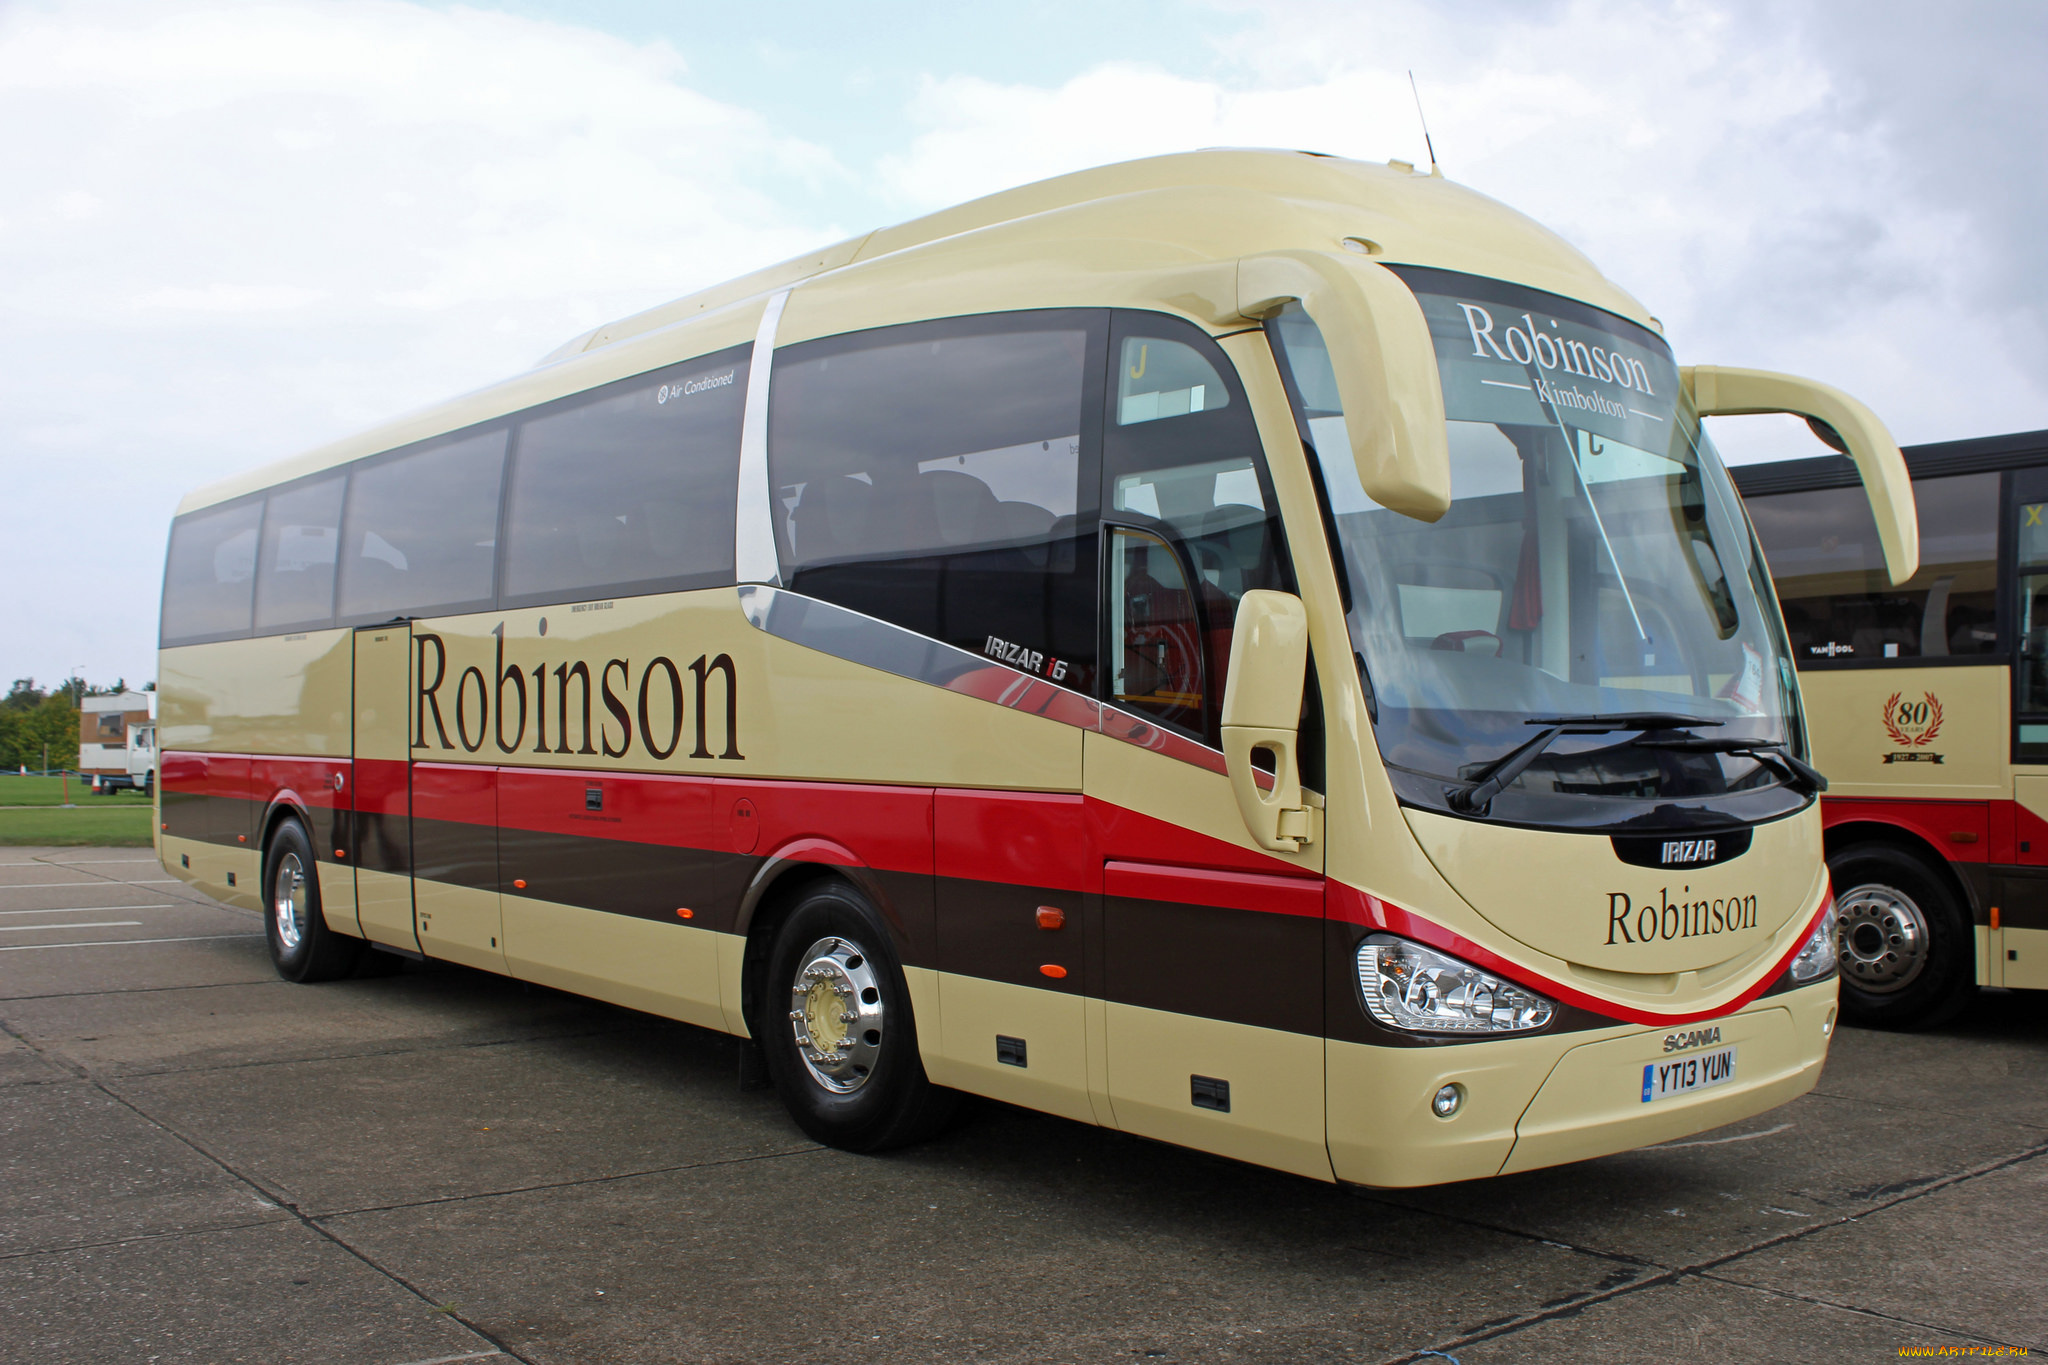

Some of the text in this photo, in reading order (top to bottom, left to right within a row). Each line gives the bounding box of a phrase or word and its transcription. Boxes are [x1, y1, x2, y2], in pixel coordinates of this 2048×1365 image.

[1130, 344, 1148, 379] J
[1457, 302, 1655, 396] Robinson
[669, 369, 735, 399] Air Conditioned
[1533, 378, 1627, 419] Kimbolton
[2025, 505, 2044, 527] X
[984, 635, 1069, 681] IRIZAR i6
[411, 616, 746, 760] Robinson
[1897, 701, 1929, 725] 80
[1661, 839, 1717, 864] IRIZAR
[1603, 885, 1758, 945] Robinson
[1663, 1026, 1721, 1052] SCANIA
[1659, 1060, 1697, 1092] YT13
[1702, 1051, 1732, 1083] YUN
